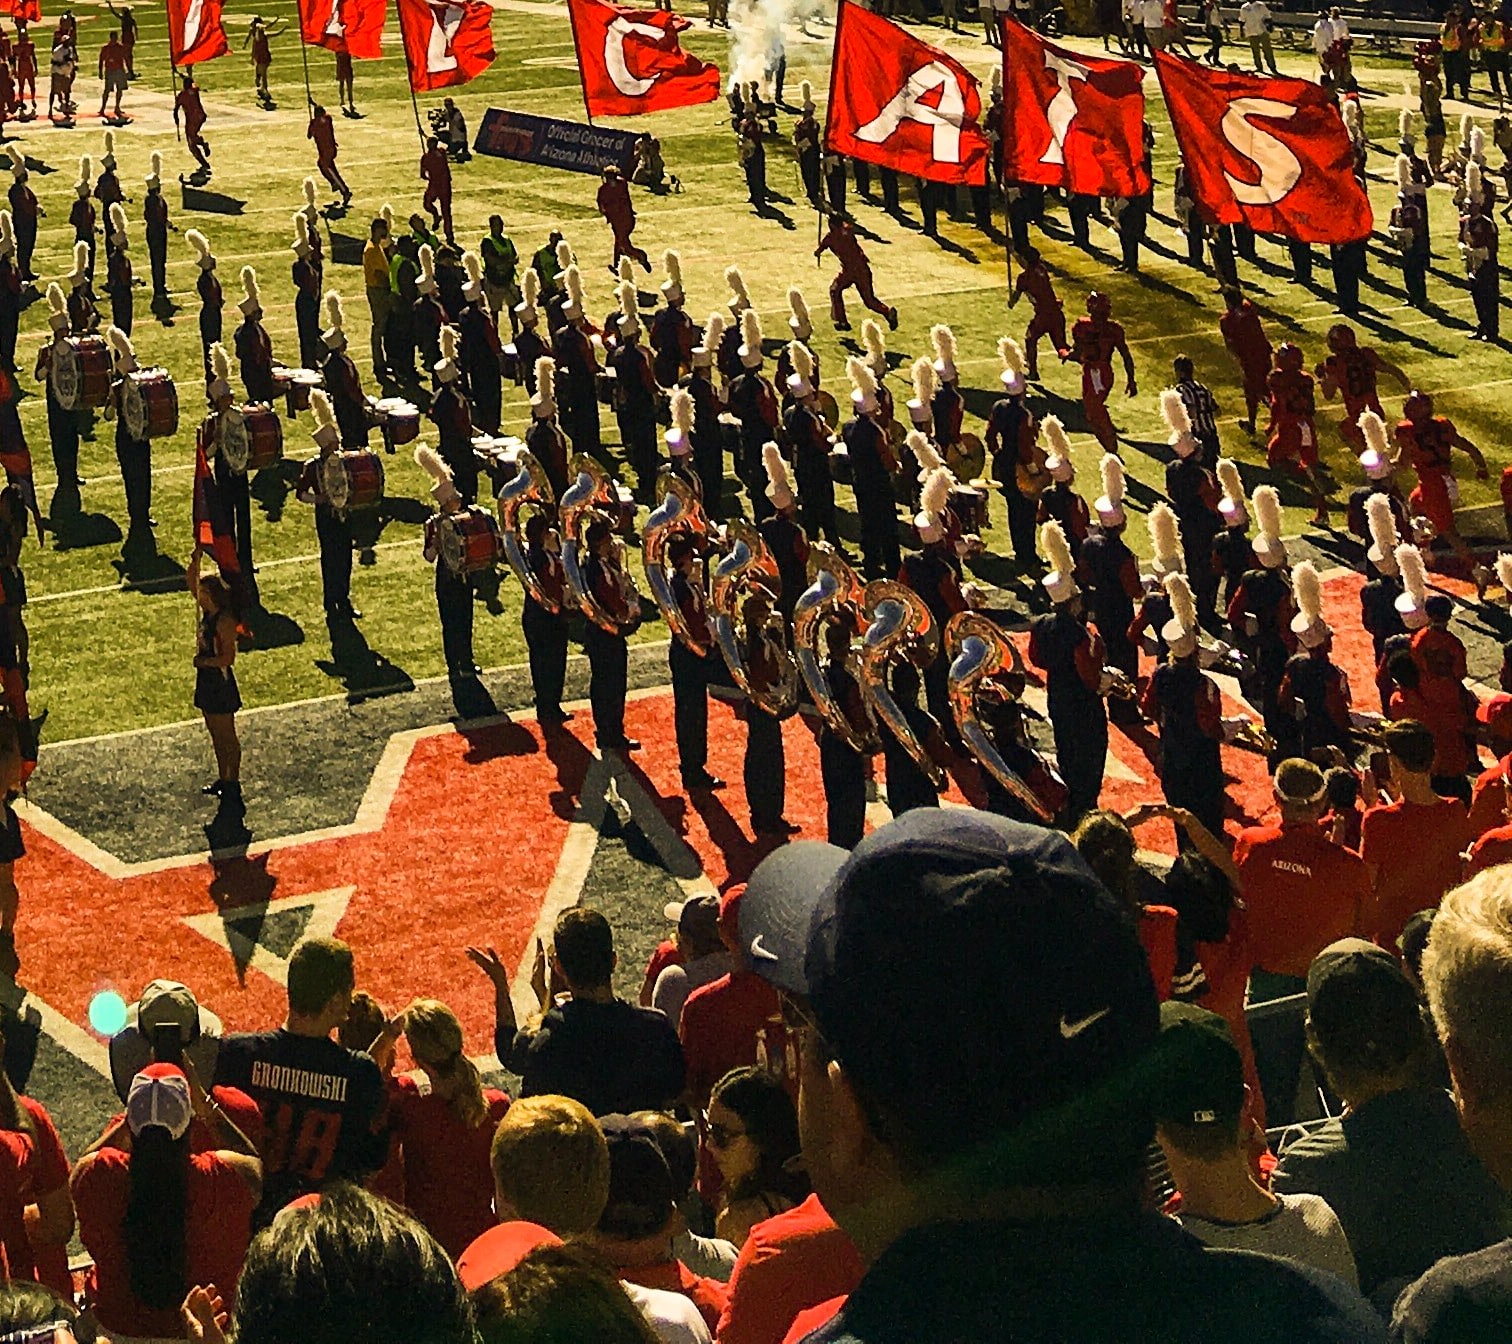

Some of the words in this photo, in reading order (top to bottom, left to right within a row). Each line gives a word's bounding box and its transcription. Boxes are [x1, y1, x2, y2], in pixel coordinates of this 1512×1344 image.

[604, 14, 667, 98] C
[854, 60, 966, 165] A
[1220, 97, 1302, 206] S
[1271, 859, 1313, 879] ARIZONA
[251, 1060, 348, 1103] GRONKOWSKI
